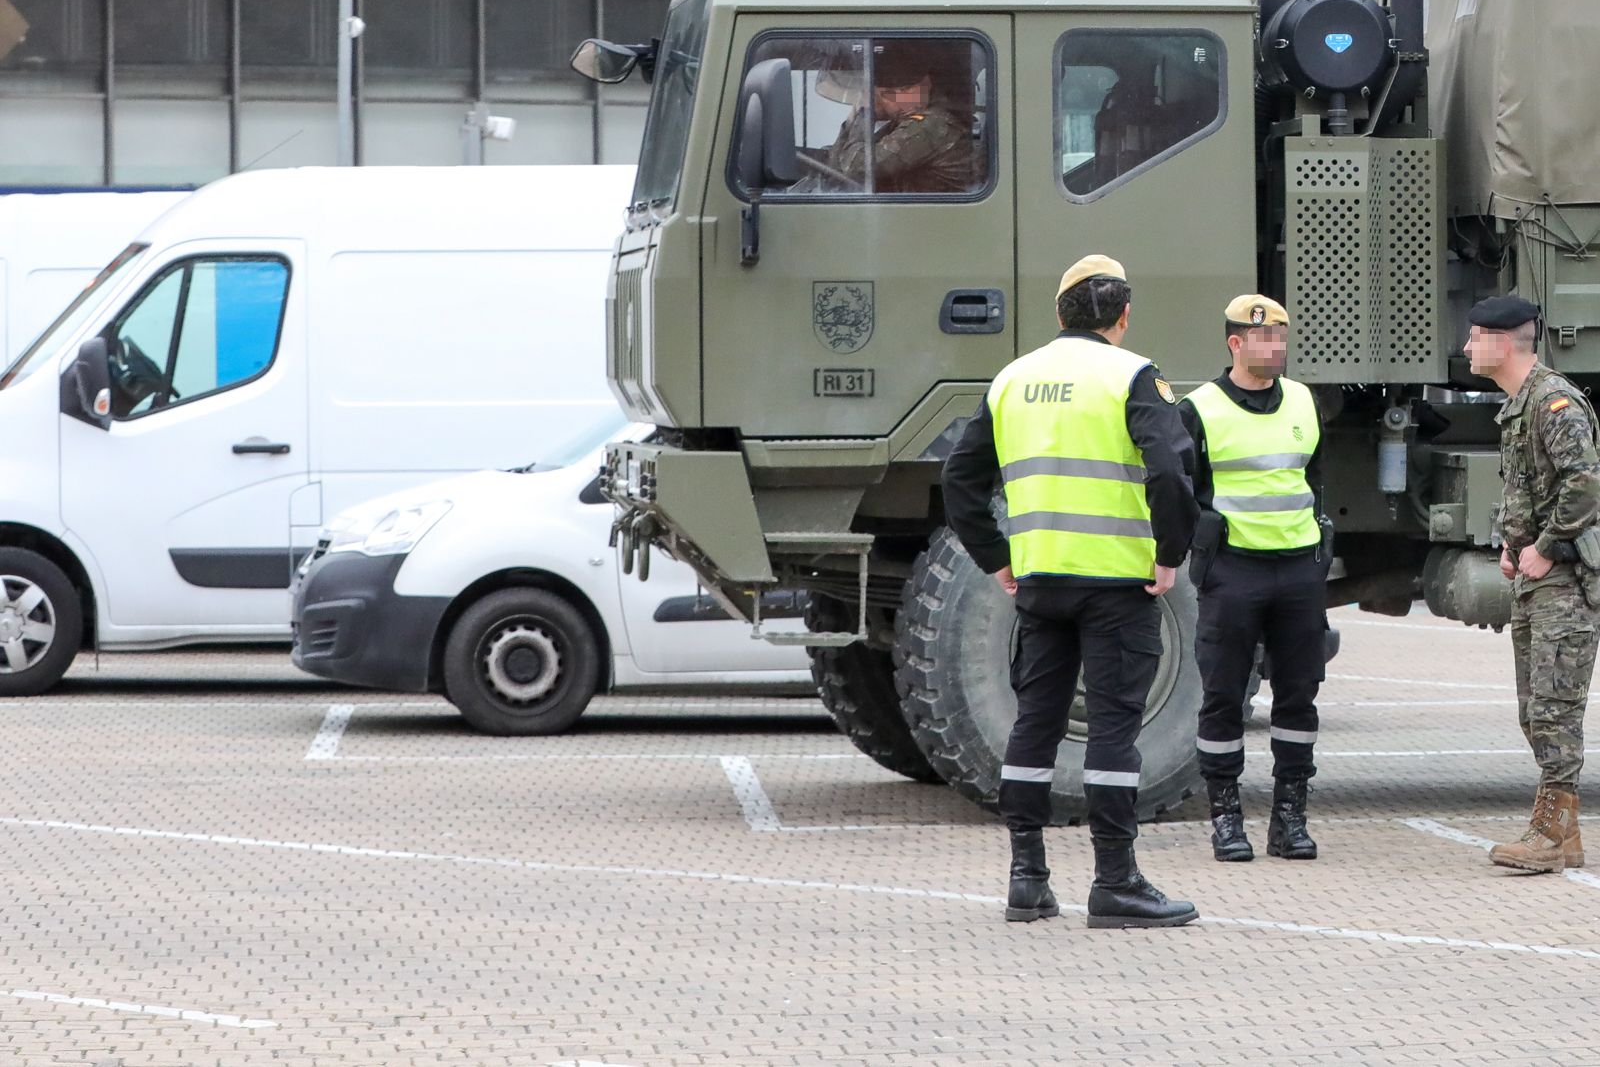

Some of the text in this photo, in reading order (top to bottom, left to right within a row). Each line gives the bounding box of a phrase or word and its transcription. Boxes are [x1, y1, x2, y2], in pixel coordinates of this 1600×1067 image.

[823, 375, 864, 391] RI 31
[1024, 383, 1074, 404] UME
